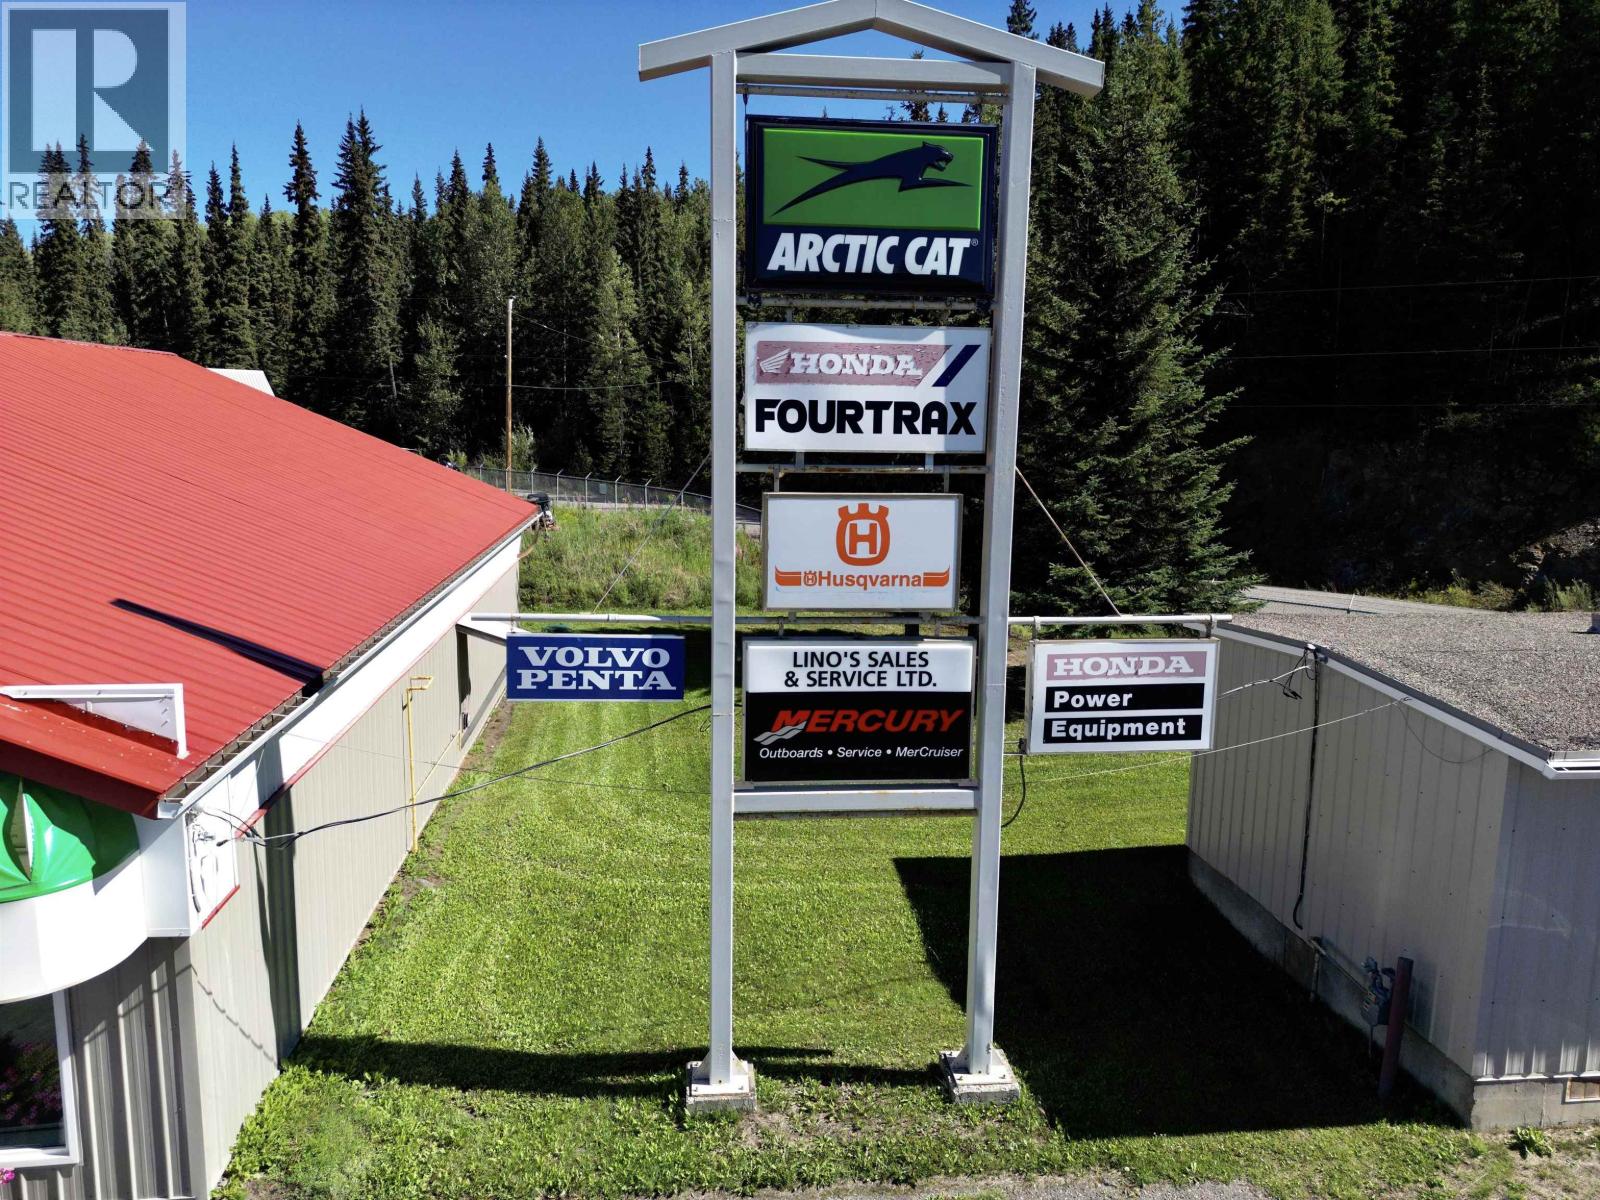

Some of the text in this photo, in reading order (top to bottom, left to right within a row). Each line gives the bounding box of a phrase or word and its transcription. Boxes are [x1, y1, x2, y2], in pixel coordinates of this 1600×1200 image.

[766, 232, 899, 275] ARCTIC
[790, 352, 923, 376] HONDA
[755, 399, 977, 436] FOURTRAX
[849, 523, 877, 555] H
[818, 571, 923, 591] Husqvarna
[518, 646, 670, 668] VOLVO
[793, 651, 929, 668] LINO'S SALES
[1053, 655, 1194, 677] HONDA
[516, 669, 677, 690] PENTA
[784, 670, 937, 687] & SERVICE LTD.
[1053, 690, 1133, 708] Power
[771, 709, 965, 733] MERCURY
[1051, 718, 1186, 740] Equipment
[759, 746, 964, 759] Outboards Service MerCruiser
